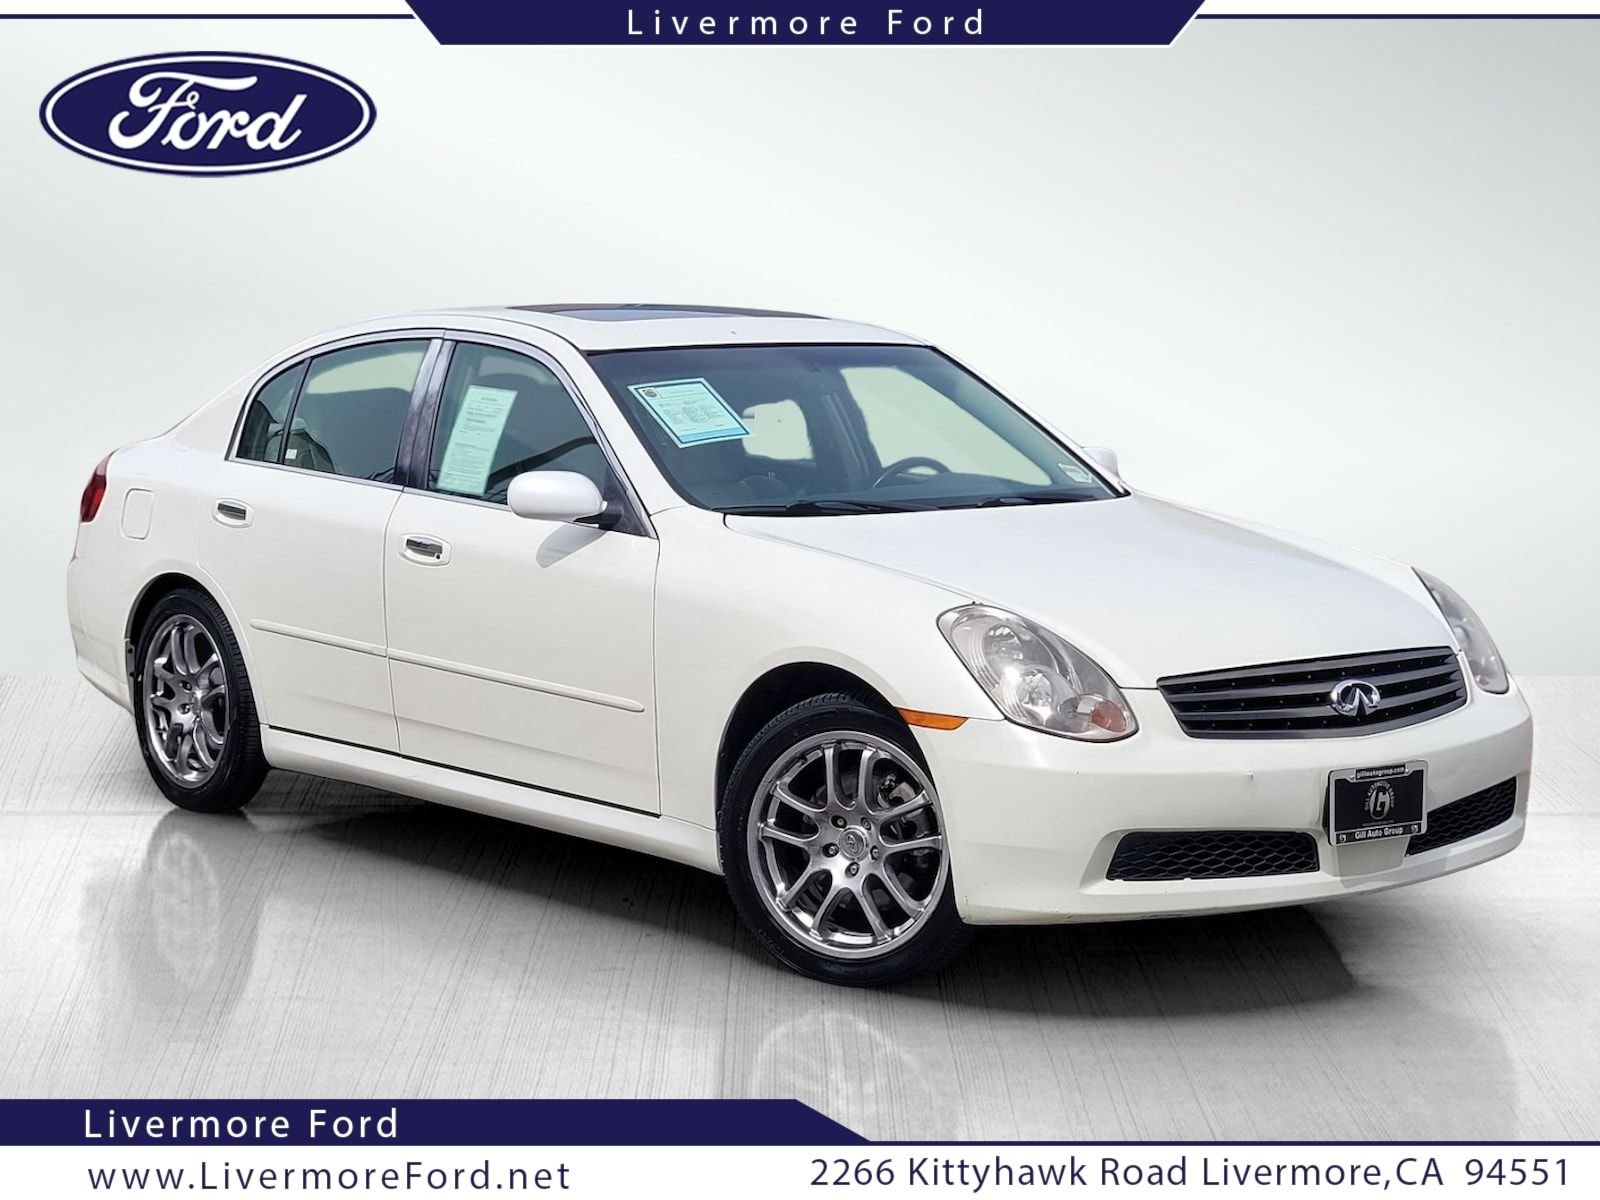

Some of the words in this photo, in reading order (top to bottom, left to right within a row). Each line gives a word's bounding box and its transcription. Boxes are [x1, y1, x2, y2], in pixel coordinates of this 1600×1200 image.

[1355, 831, 1367, 840] Gill
[1367, 829, 1383, 838] Auto
[1384, 827, 1404, 836] Group
